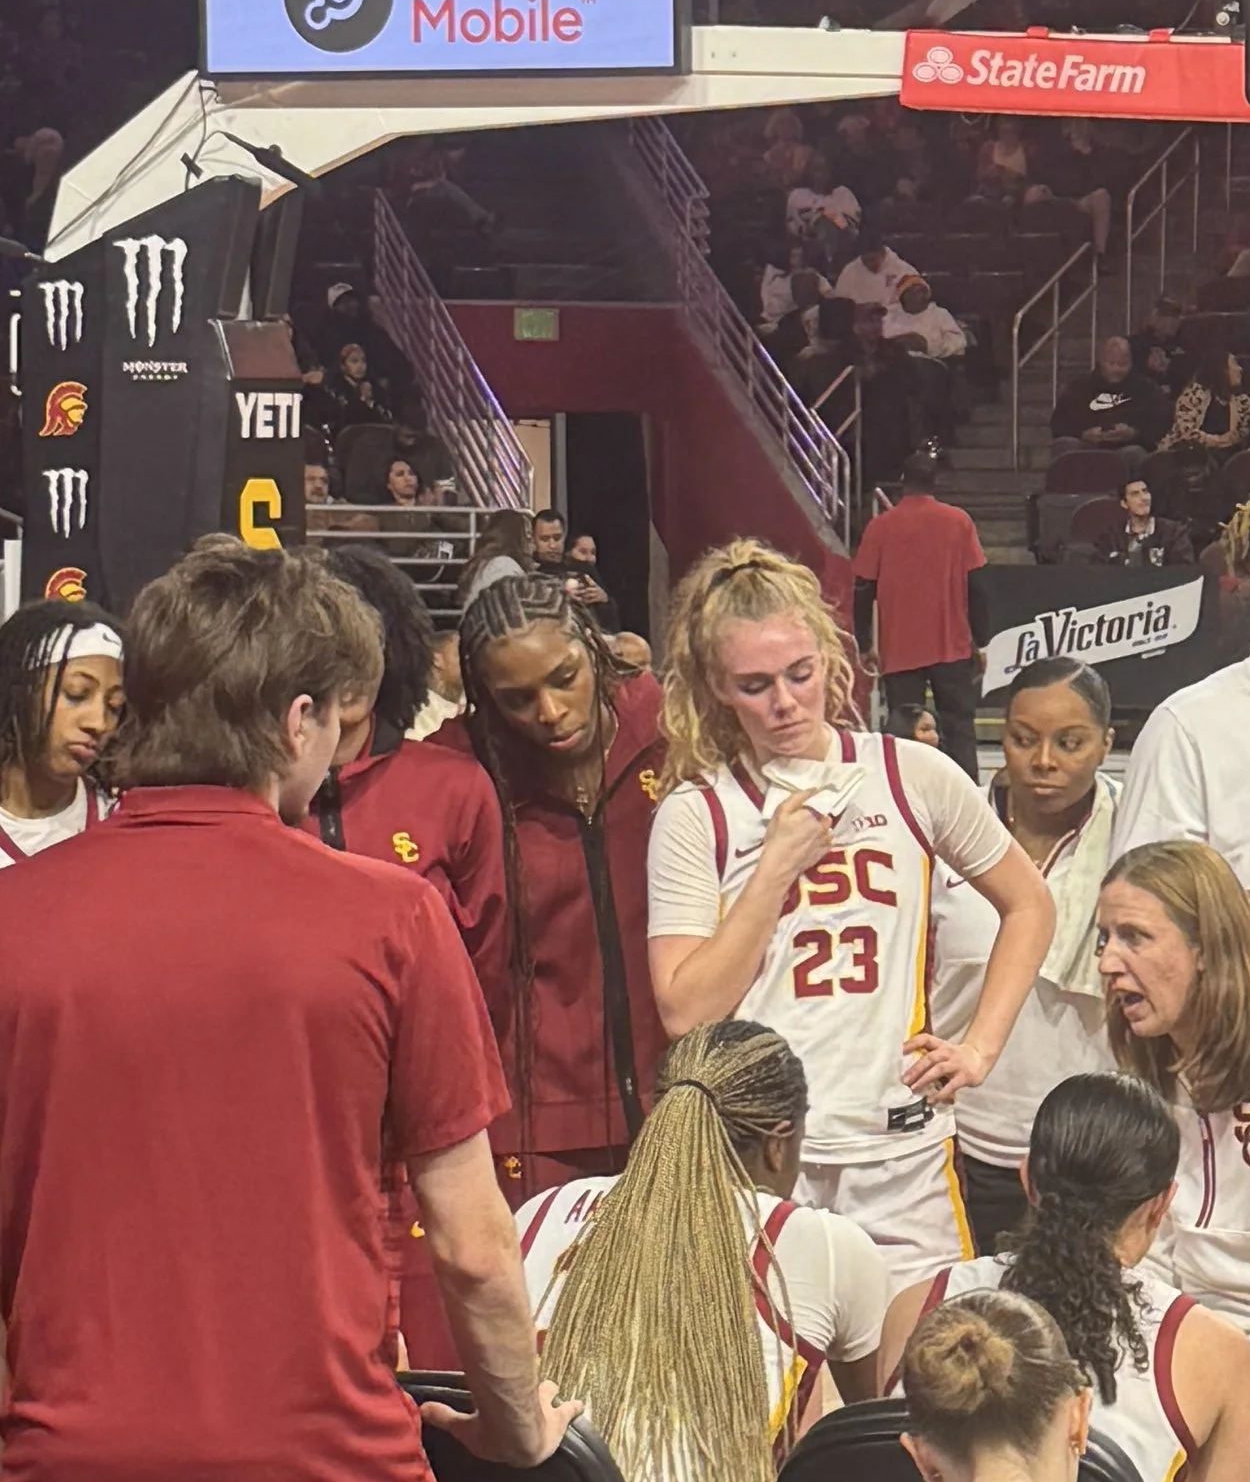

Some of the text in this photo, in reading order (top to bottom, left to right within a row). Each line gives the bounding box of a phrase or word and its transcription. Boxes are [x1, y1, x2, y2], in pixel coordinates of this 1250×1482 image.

[122, 360, 188, 374] MONSTER
[235, 392, 303, 439] YETI
[1039, 601, 1173, 657] Victoria
[392, 832, 419, 863] SC
[780, 848, 898, 918] SC
[793, 925, 879, 999] 23
